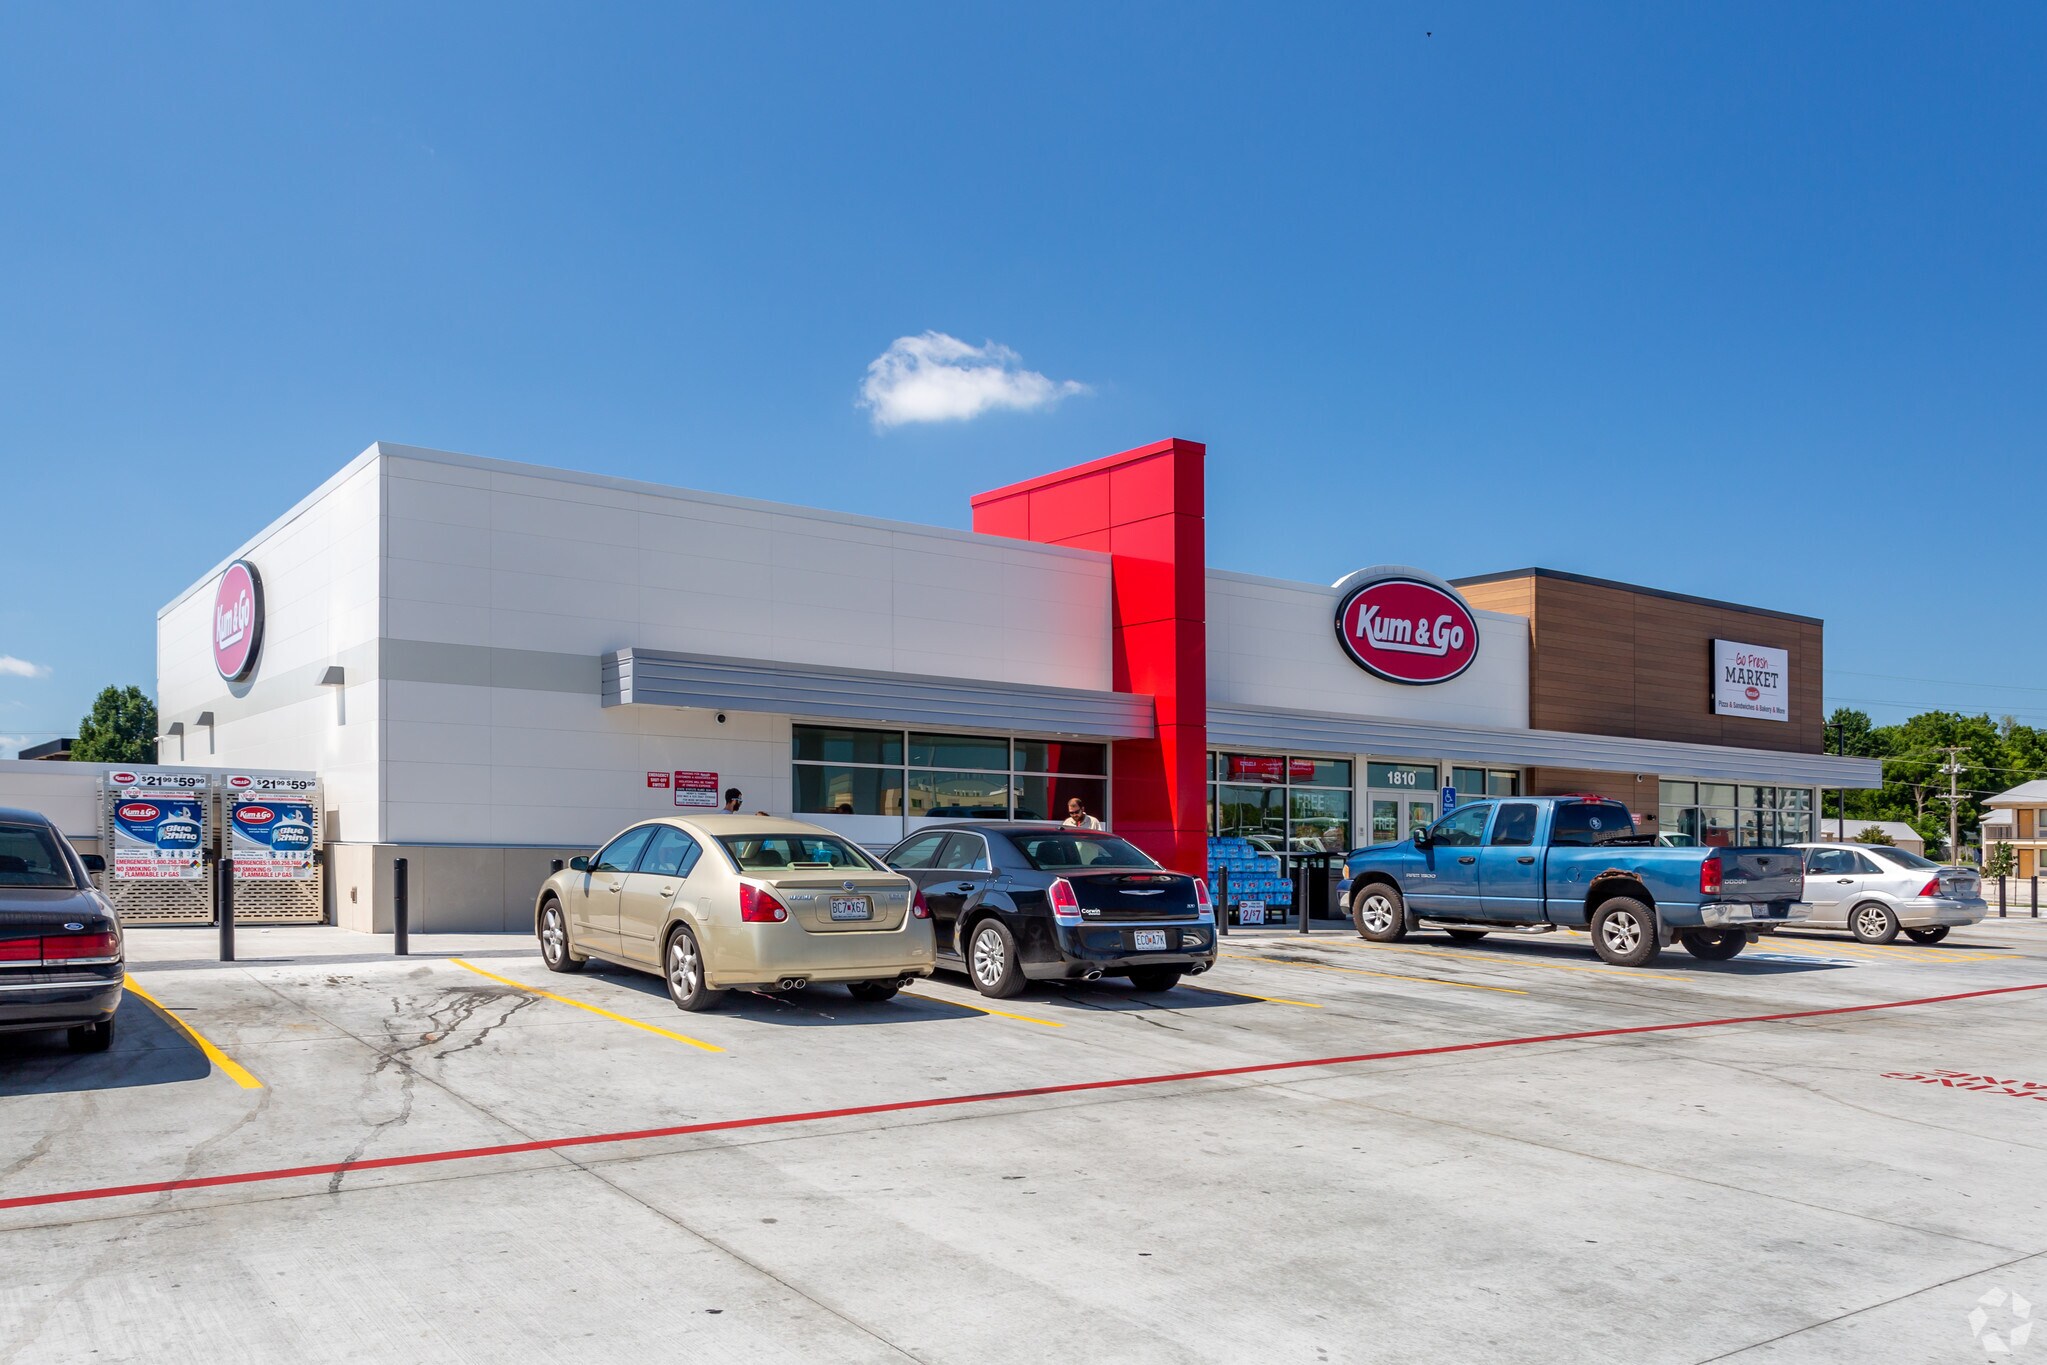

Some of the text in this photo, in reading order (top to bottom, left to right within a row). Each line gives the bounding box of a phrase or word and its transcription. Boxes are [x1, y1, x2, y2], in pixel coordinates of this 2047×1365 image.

[1736, 652, 1768, 669] Go Fresh
[1726, 666, 1778, 688] MARKET
[1733, 702, 1754, 710] Sandwiches
[1760, 705, 1772, 713] Bakery
[1388, 772, 1415, 785] 1810
[1297, 794, 1324, 810] FREE
[1374, 818, 1396, 830] FREE
[833, 901, 866, 913] BC7 X6Z
[1153, 934, 1165, 945] A7K
